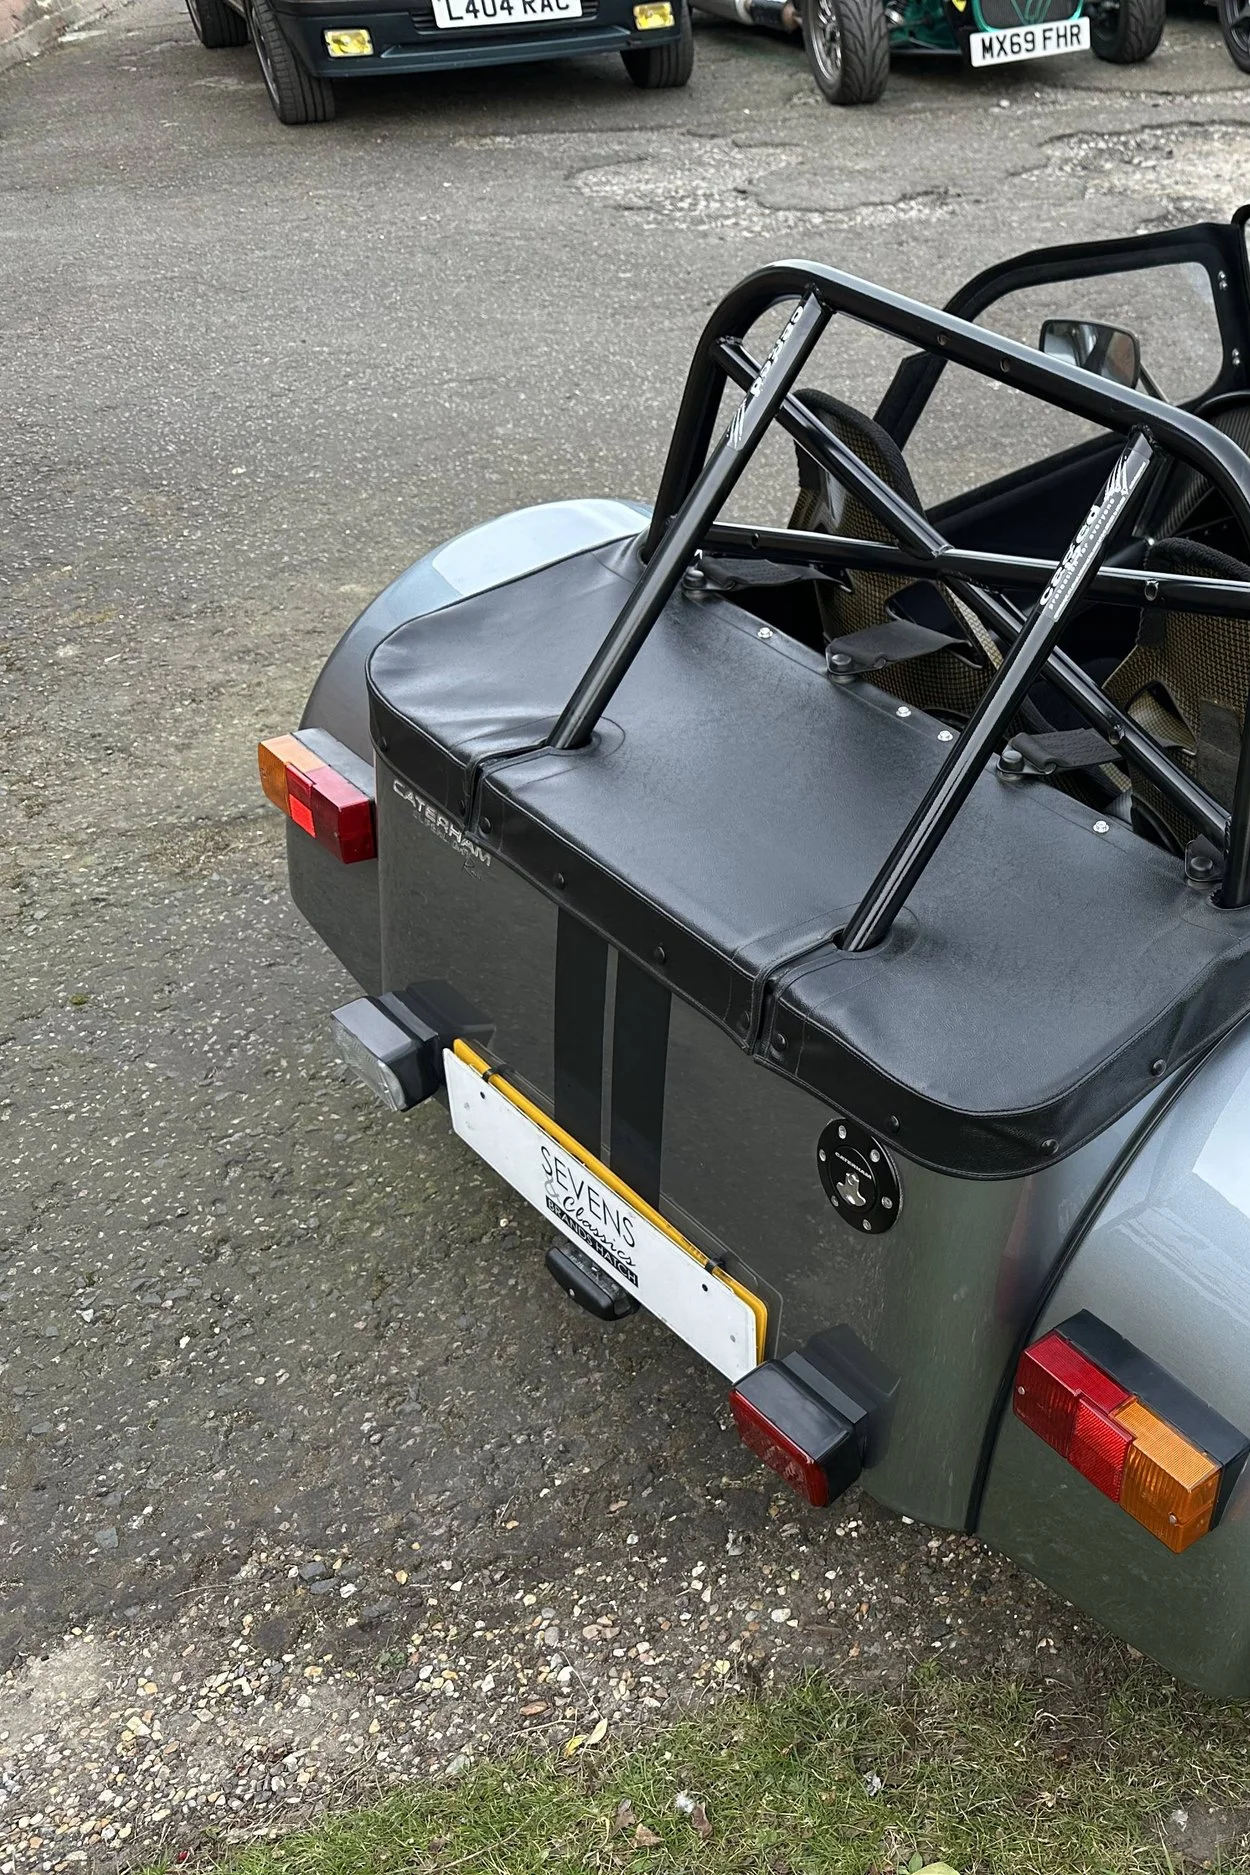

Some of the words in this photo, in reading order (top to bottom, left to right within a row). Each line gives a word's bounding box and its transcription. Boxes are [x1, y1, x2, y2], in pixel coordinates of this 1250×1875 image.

[445, 0, 514, 21] L404
[981, 31, 1036, 60] MX69
[1042, 24, 1081, 51] FHR
[393, 779, 491, 867] CATERHAM
[541, 1145, 635, 1248] SEVENS
[835, 1151, 872, 1180] CATERHAM
[548, 1200, 593, 1247] BRANDS
[595, 1243, 637, 1286] HATCH
[563, 1196, 636, 1267] Classics
